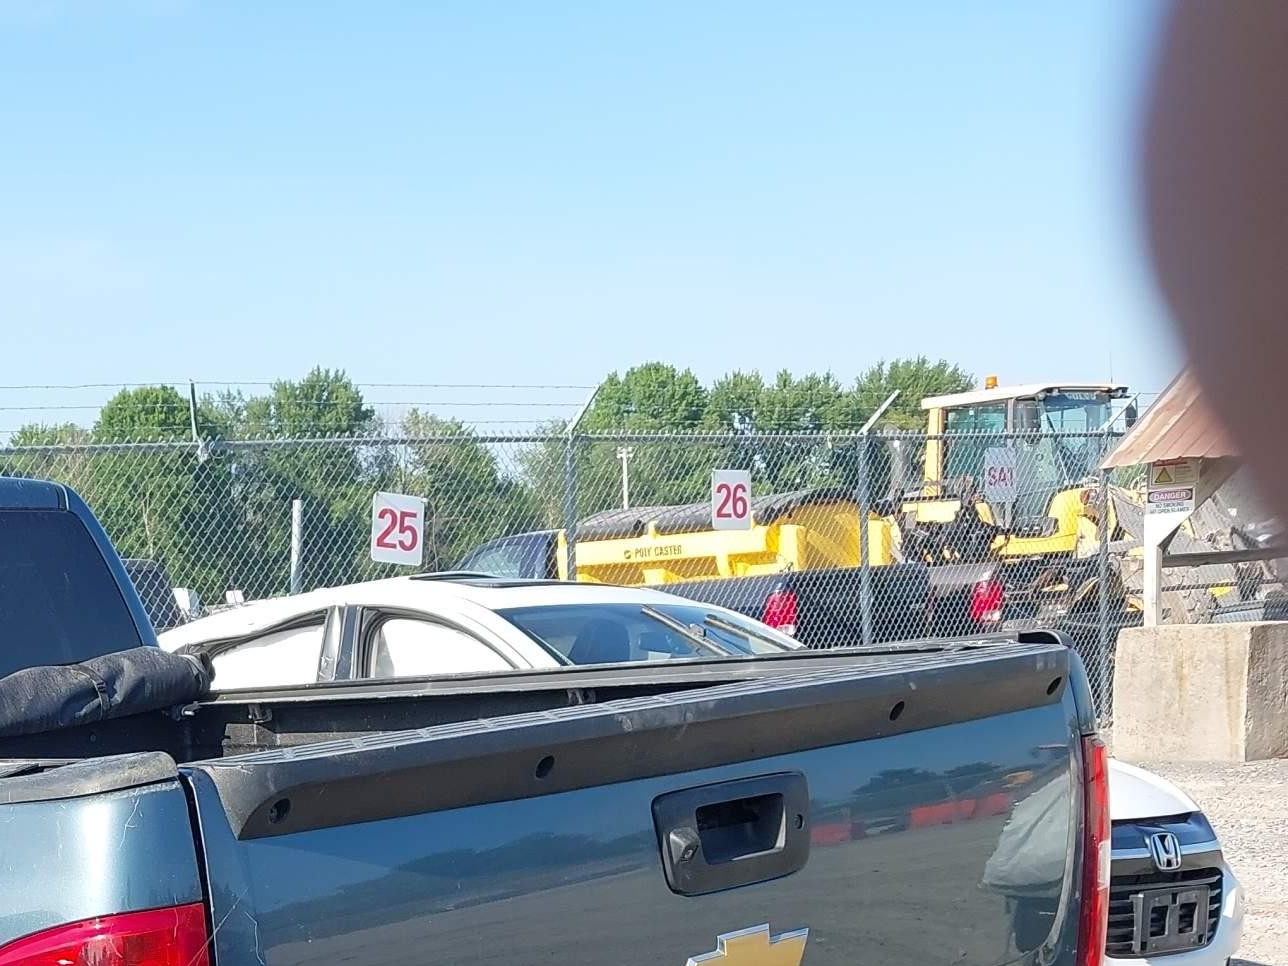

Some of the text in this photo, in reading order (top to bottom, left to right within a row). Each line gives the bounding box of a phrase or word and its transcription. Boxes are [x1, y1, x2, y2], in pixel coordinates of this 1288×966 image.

[716, 483, 748, 519] 26
[1153, 491, 1187, 501] DANGER
[376, 507, 418, 552] 25
[635, 545, 682, 558] POLY CASTER
